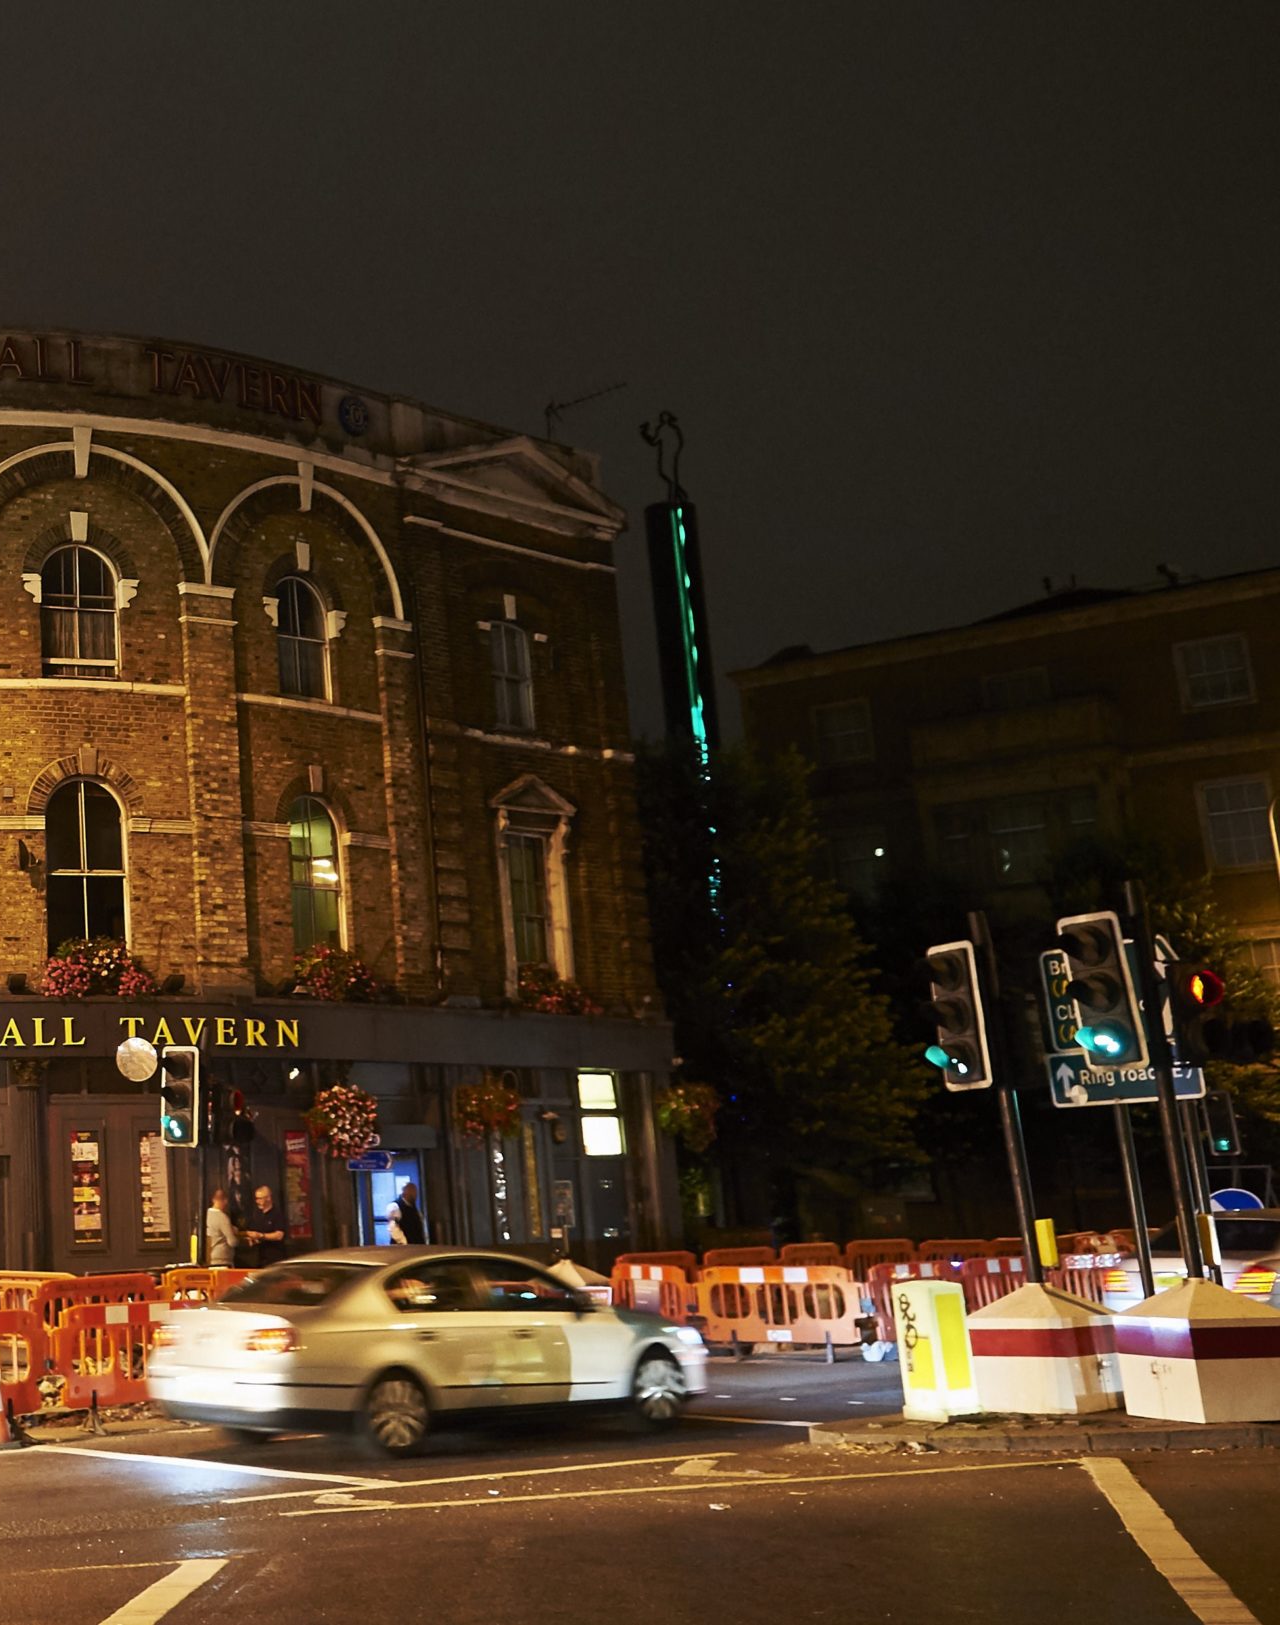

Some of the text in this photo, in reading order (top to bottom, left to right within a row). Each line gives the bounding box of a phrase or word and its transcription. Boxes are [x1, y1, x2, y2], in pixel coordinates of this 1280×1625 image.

[144, 347, 322, 426] TAVERN
[119, 1016, 300, 1047] TAVERN
[1079, 1069, 1116, 1087] Ring
